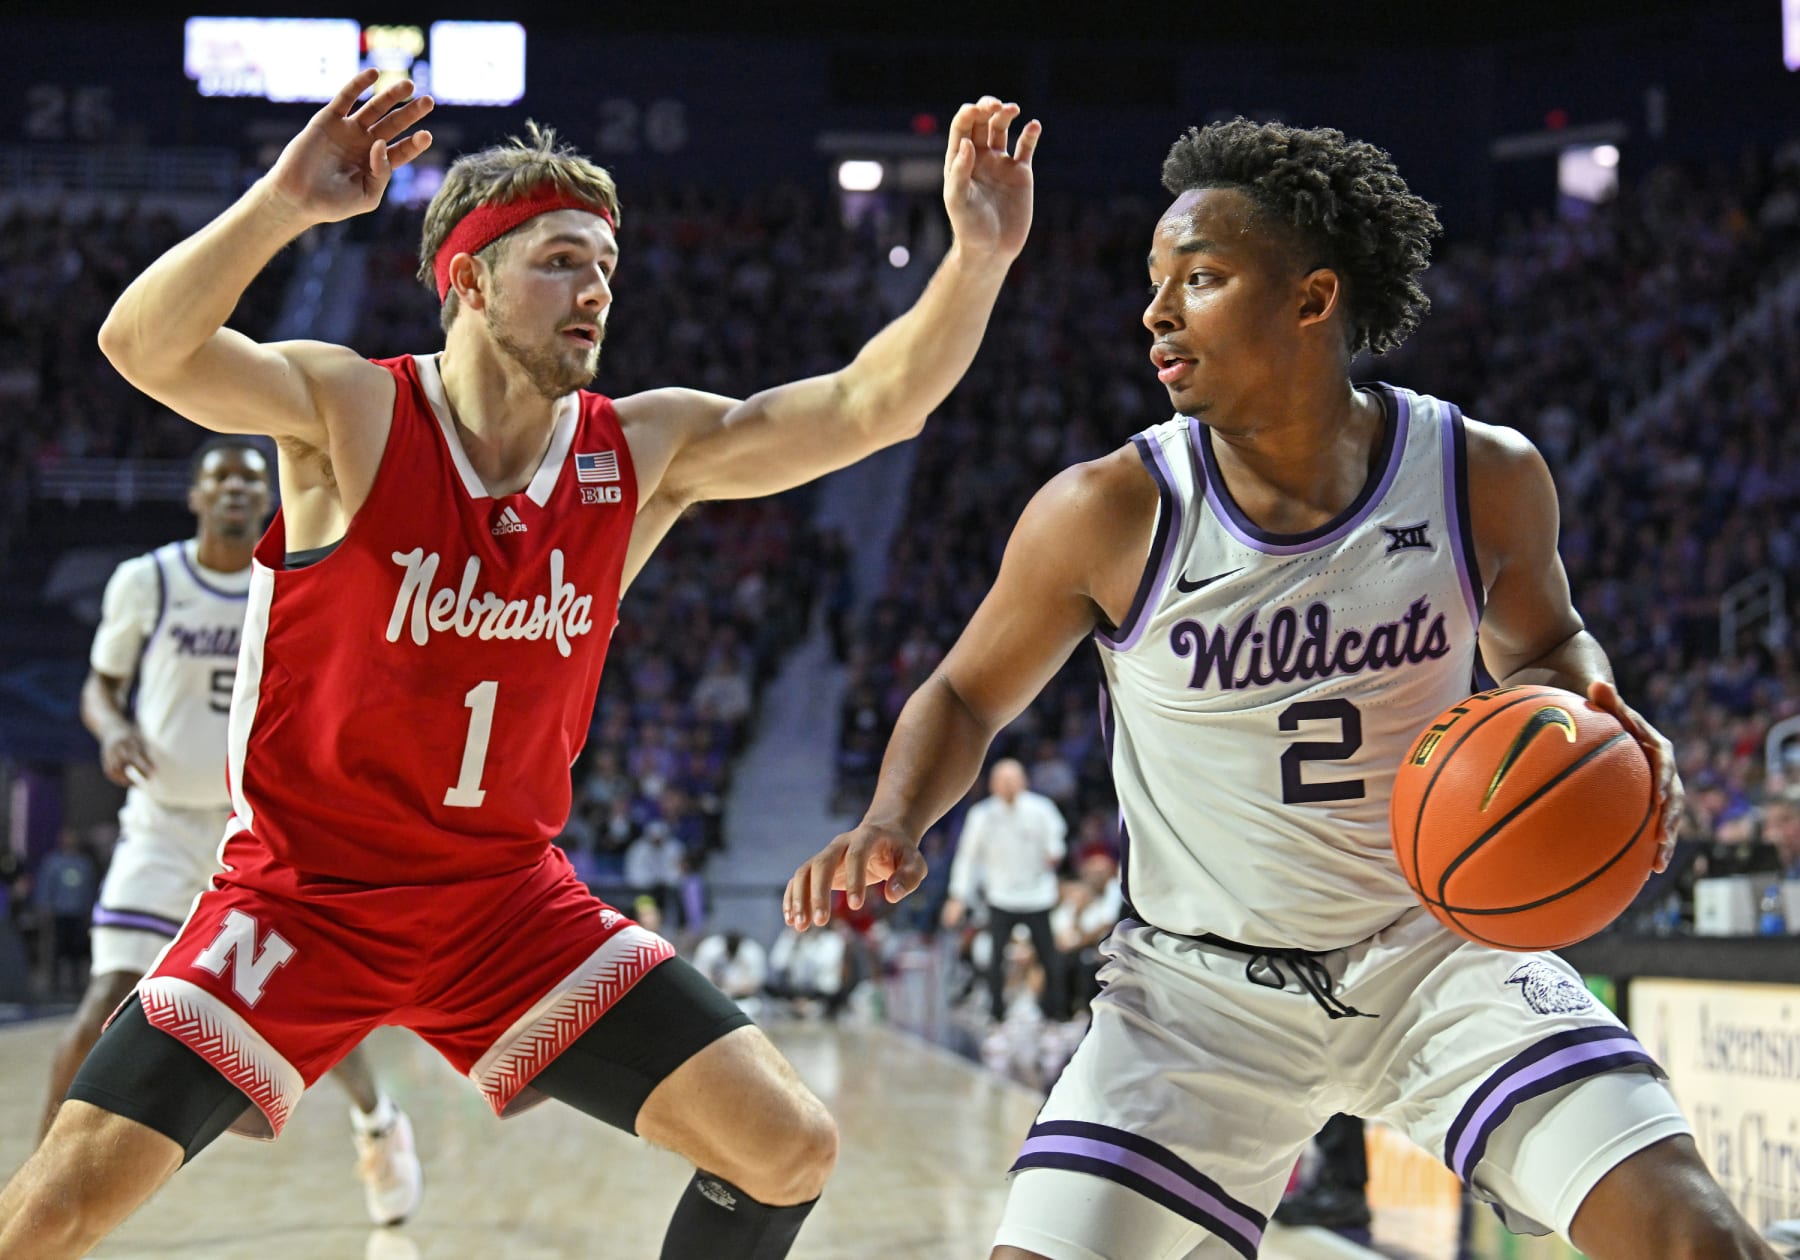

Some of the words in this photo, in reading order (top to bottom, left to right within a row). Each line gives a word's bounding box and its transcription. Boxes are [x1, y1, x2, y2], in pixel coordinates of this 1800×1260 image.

[492, 522, 528, 536] adidas
[386, 547, 593, 658] Nebraska
[1169, 594, 1451, 691] Wildcats
[443, 681, 498, 807] 1
[1278, 698, 1365, 804] 2
[191, 907, 297, 1010] N
